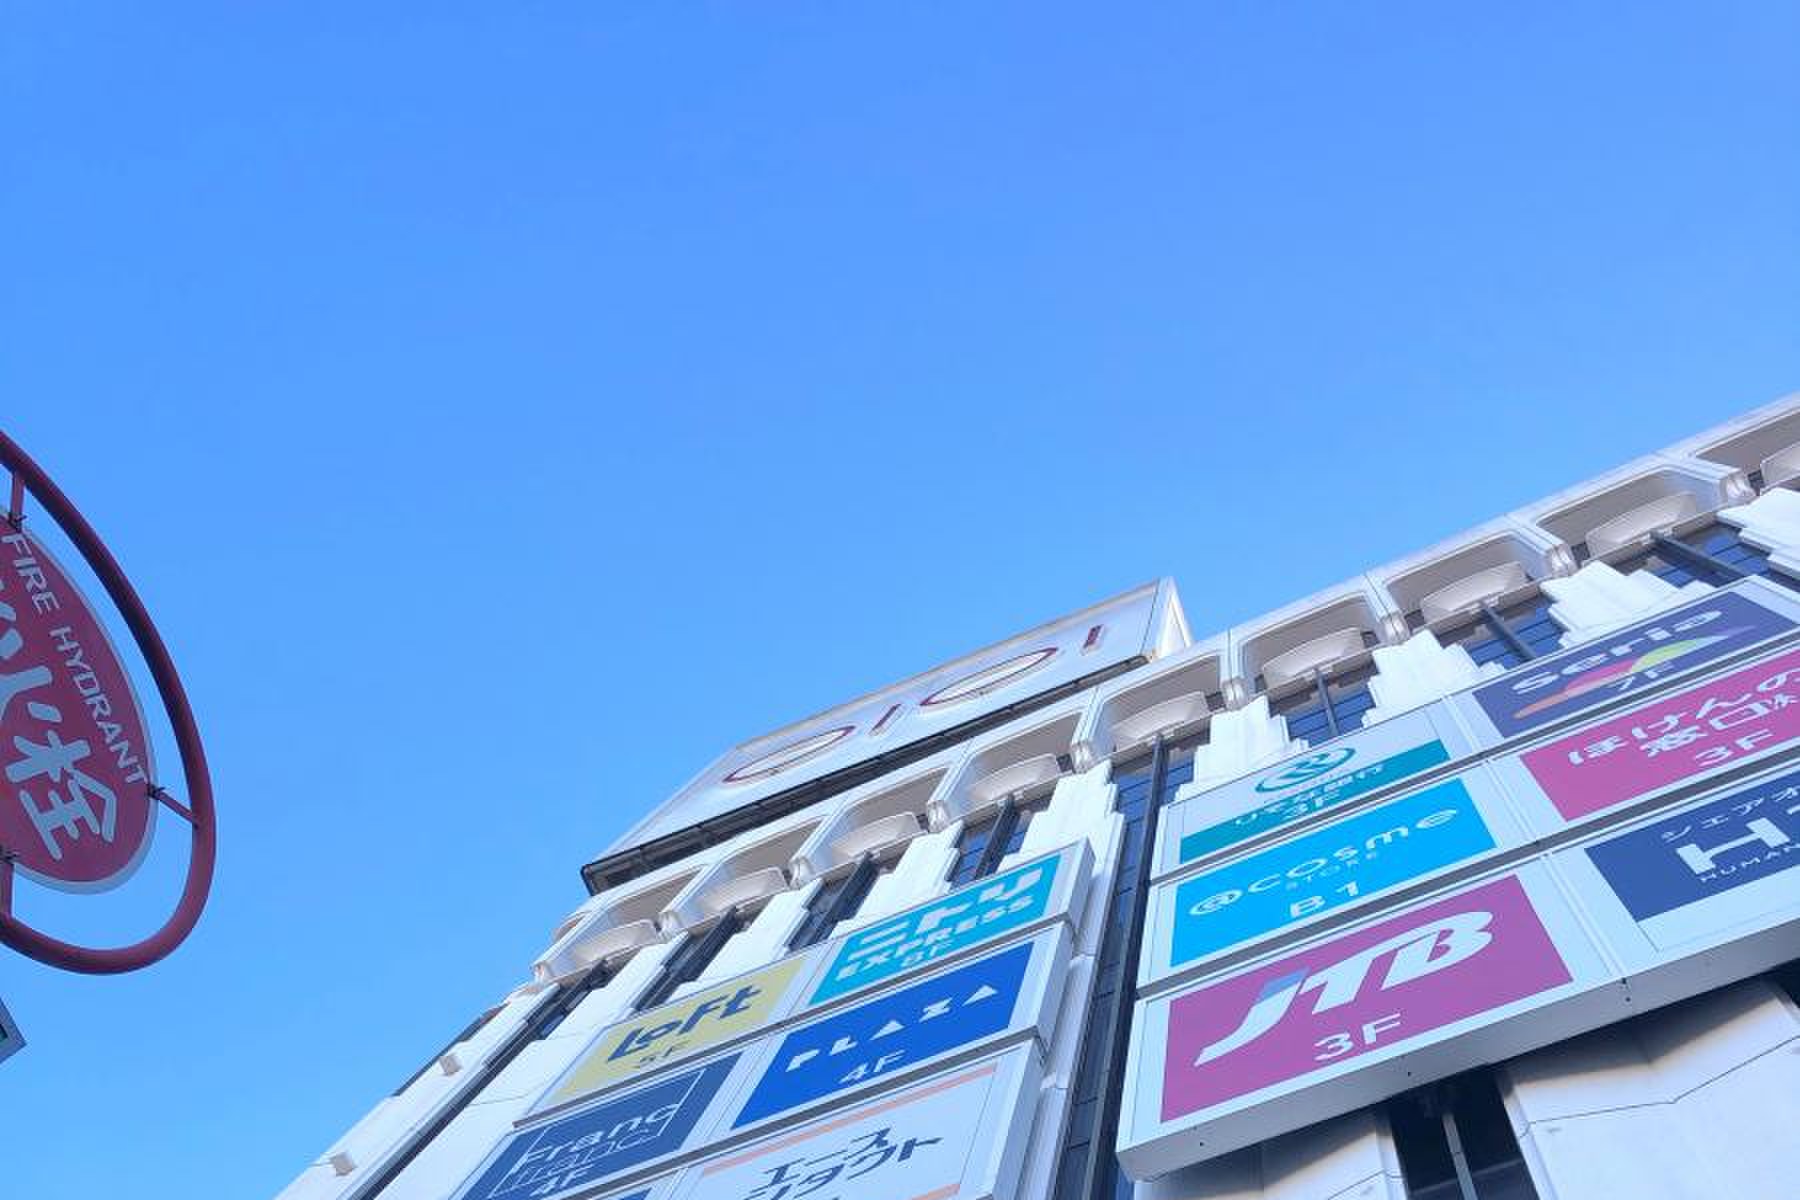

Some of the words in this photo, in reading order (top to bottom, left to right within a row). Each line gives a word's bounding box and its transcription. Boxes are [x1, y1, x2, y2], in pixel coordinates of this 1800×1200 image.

[1, 533, 60, 615] FIRE
[50, 625, 149, 784] HYDRANT
[1512, 610, 1722, 694] Seria
[1694, 728, 1775, 768] 3F
[1190, 808, 1458, 916] @cosme
[1289, 881, 1360, 919] B1
[834, 896, 1034, 982] EXPRESS
[847, 867, 1043, 961] ニトリ
[1193, 911, 1494, 1067] JTB
[785, 984, 999, 1072] PLAZA
[1313, 1010, 1402, 1062] 3F
[837, 1049, 906, 1085] 4F
[509, 1103, 681, 1174] Franc
[752, 1127, 892, 1193] エース
[529, 1163, 594, 1197] 4F
